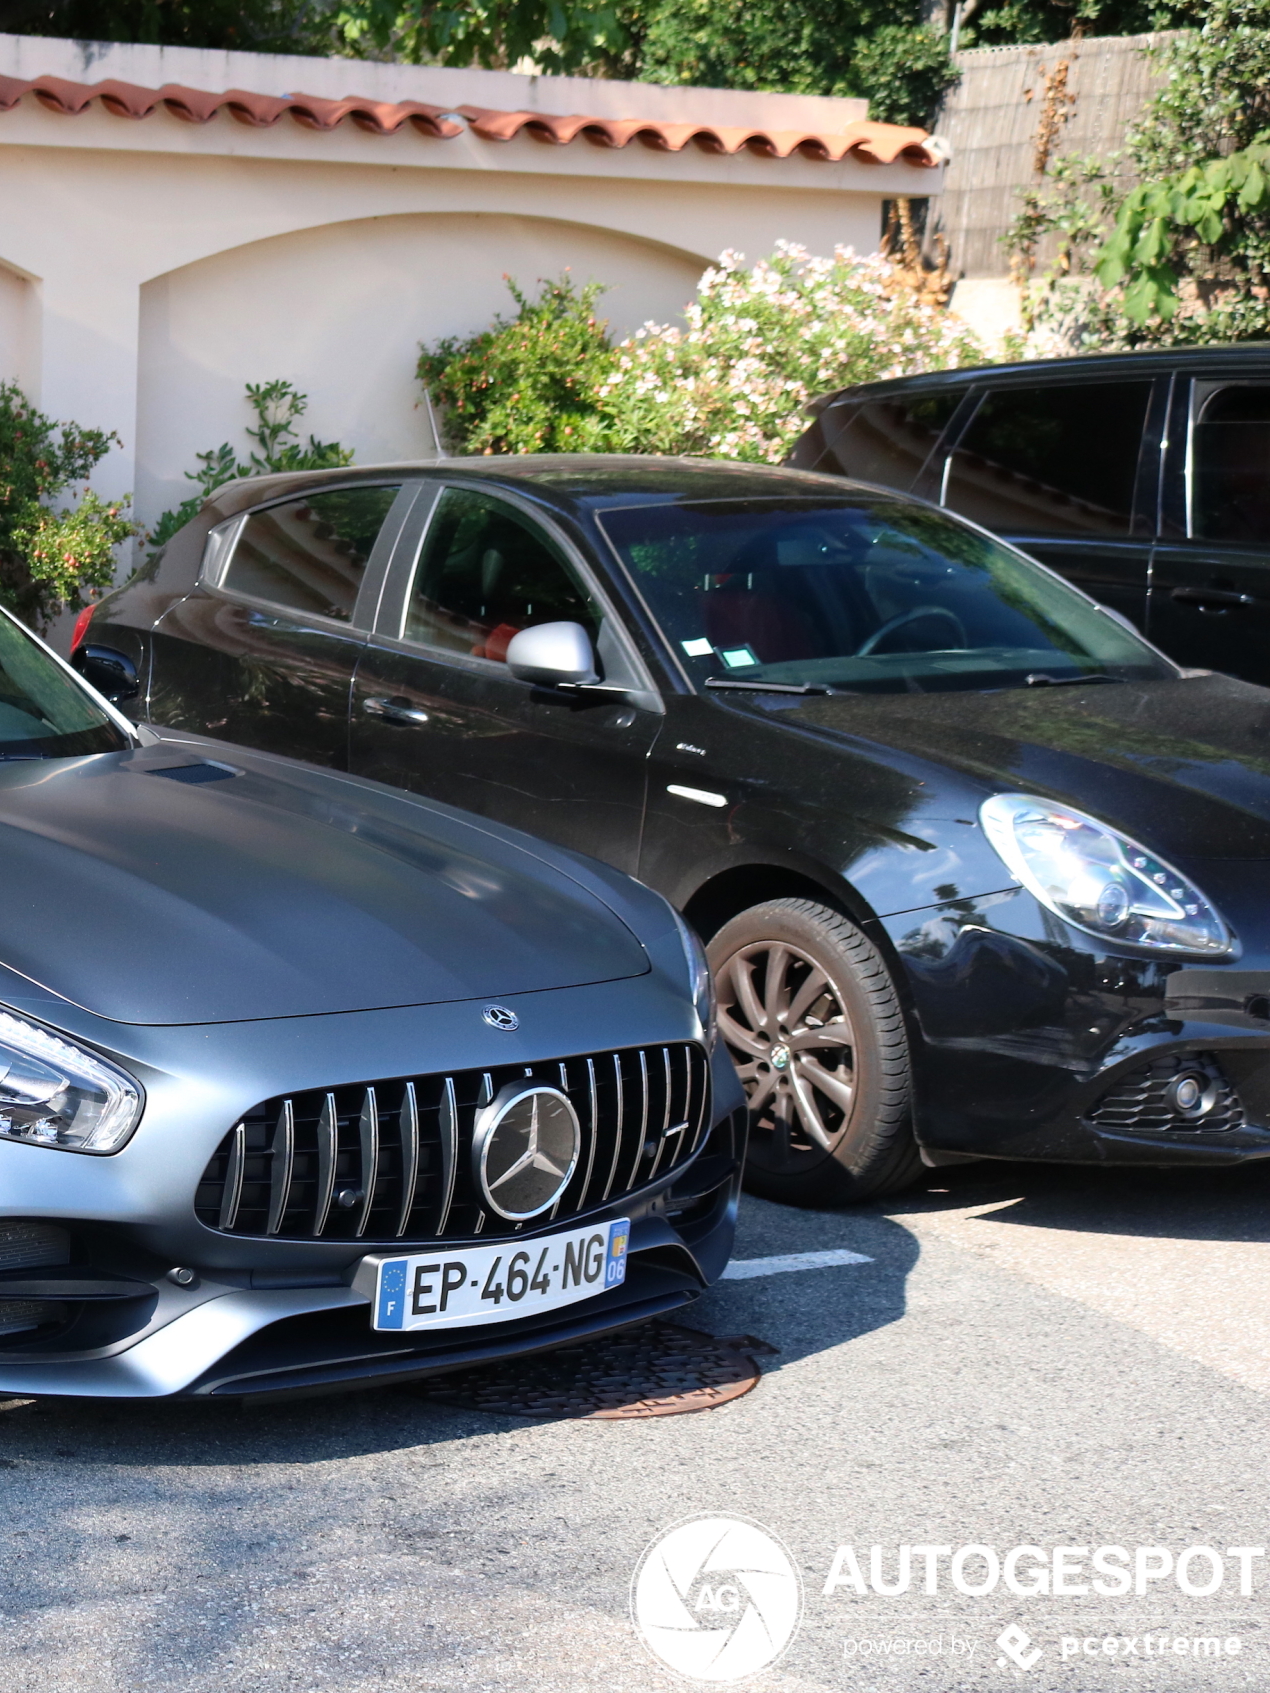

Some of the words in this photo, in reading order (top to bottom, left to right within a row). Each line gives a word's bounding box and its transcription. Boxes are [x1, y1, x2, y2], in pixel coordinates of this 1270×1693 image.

[411, 1233, 605, 1316] EP-464-NG
[607, 1258, 626, 1282] 06
[386, 1300, 396, 1316] F
